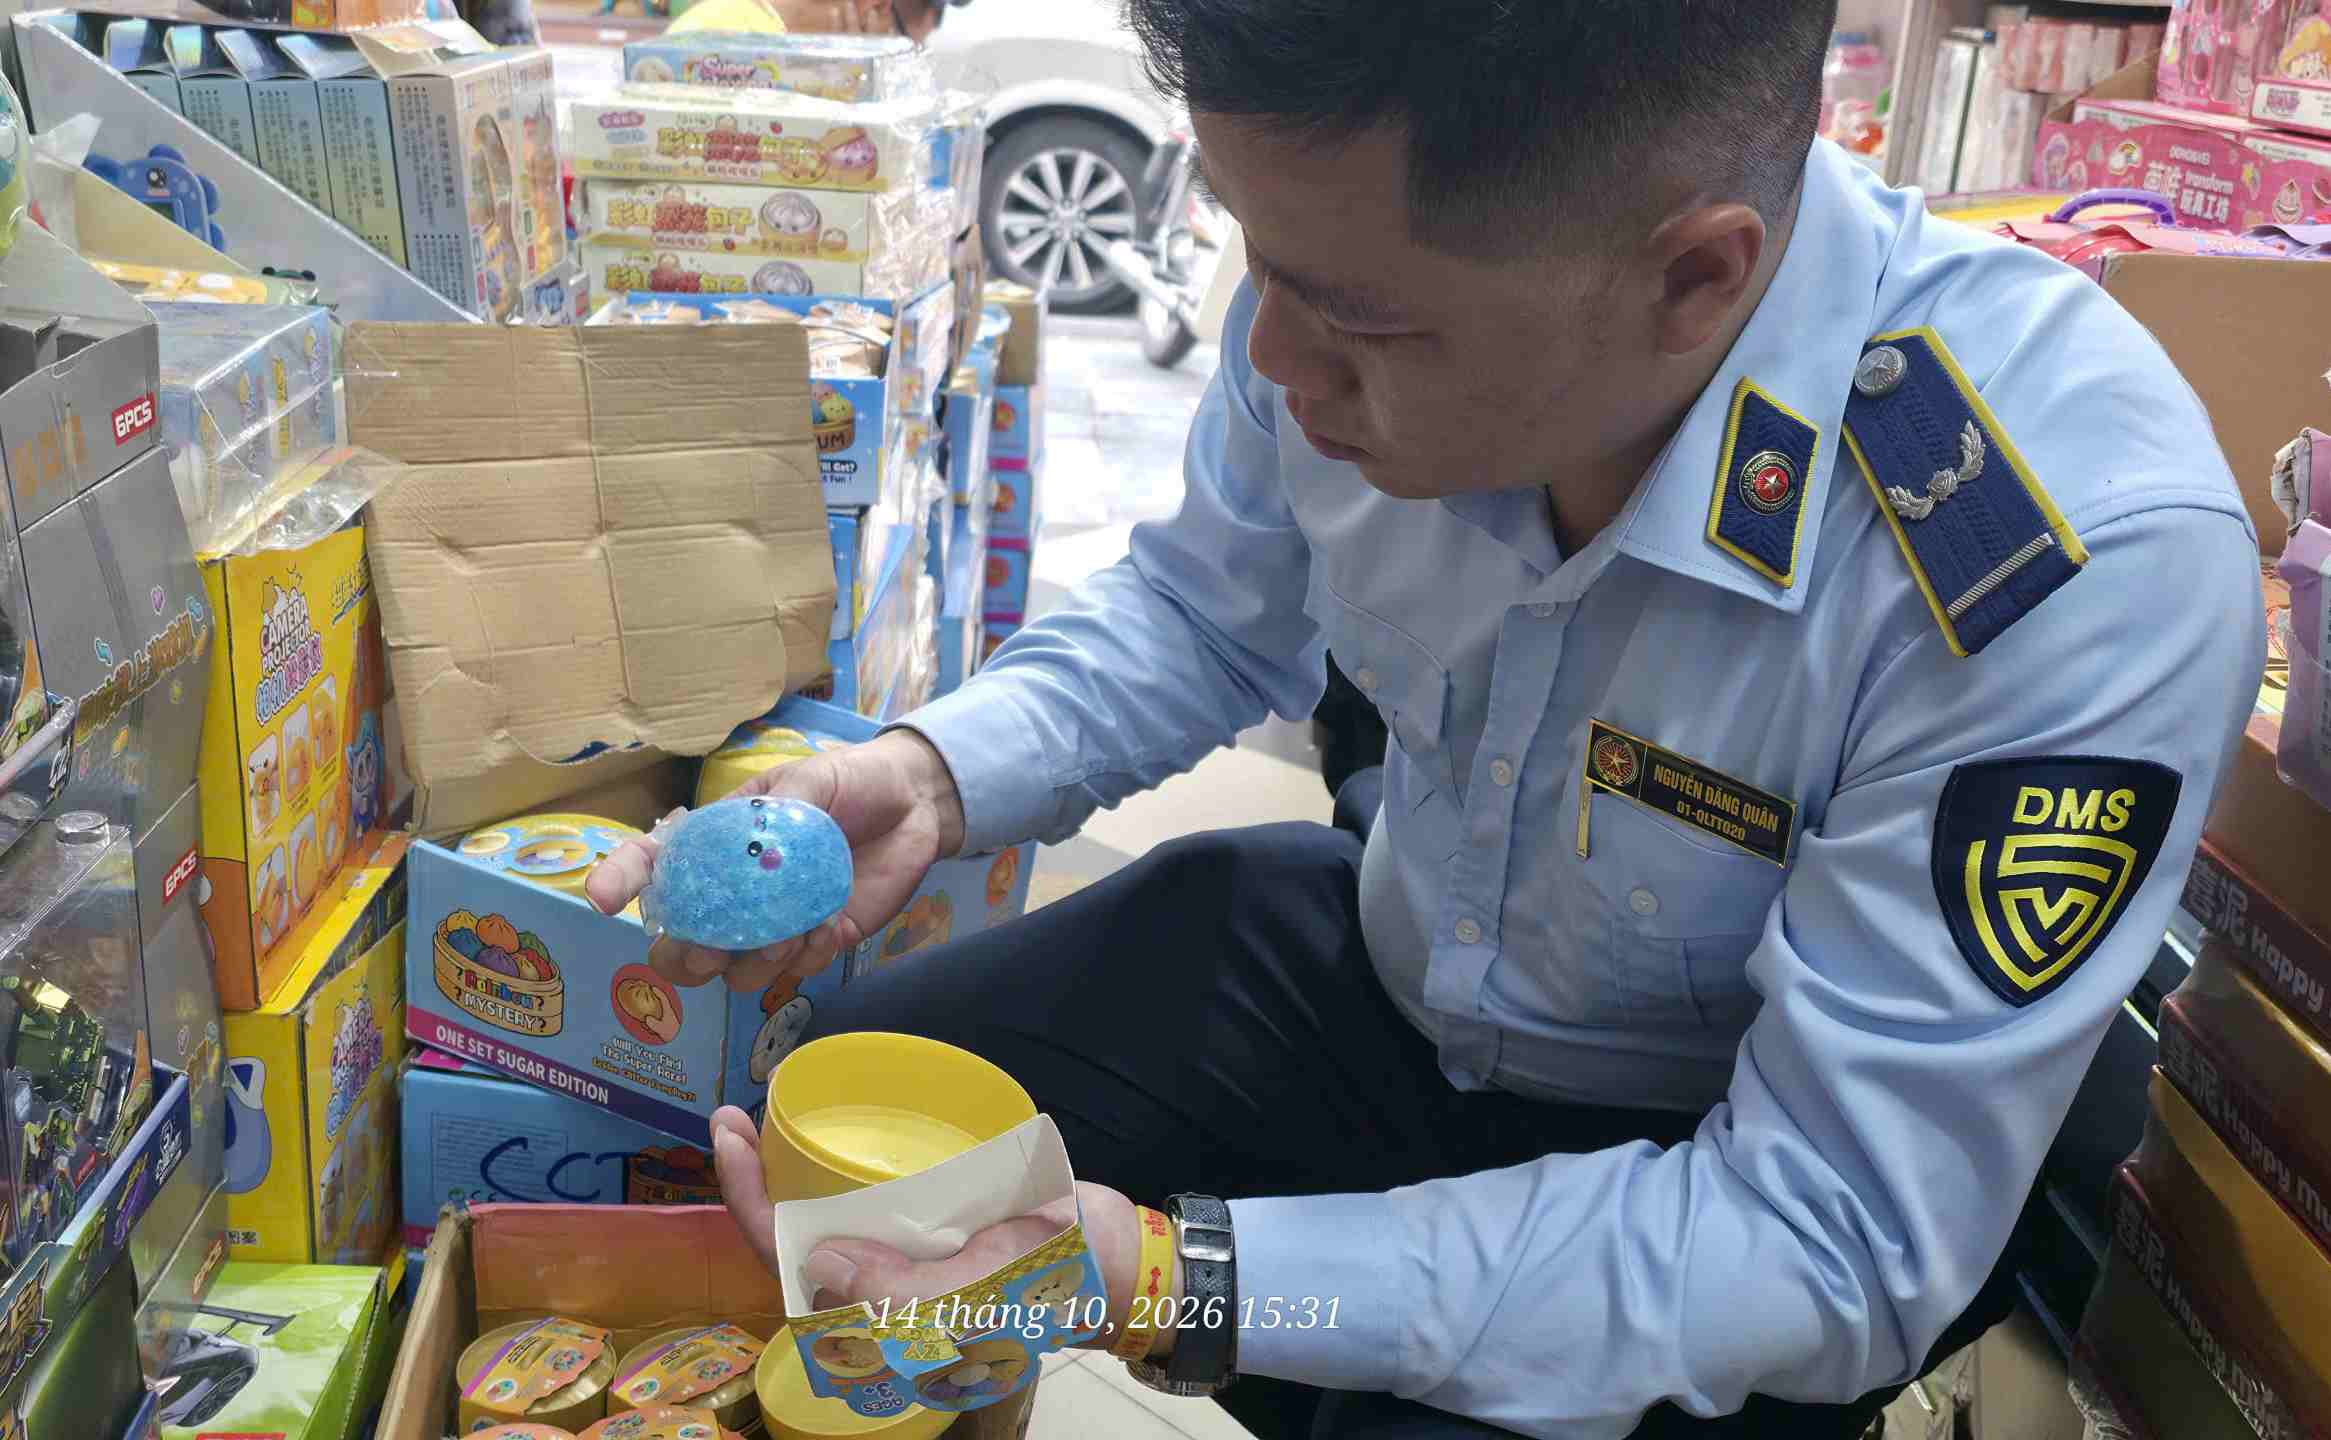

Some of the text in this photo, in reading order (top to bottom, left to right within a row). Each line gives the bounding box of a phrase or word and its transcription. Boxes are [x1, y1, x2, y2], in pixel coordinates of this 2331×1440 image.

[115, 400, 153, 438] 6PCS
[1742, 800, 1778, 832] QUÂN
[2012, 786, 2137, 832] DMS
[2250, 921, 2326, 1013] Happy
[464, 993, 536, 1031] MYSTERY
[436, 1025, 465, 1049] ONE
[468, 1037, 494, 1060] SET
[497, 1049, 546, 1081] SUGAR
[550, 1068, 609, 1104] EDITION
[2223, 1103, 2291, 1193] Happy
